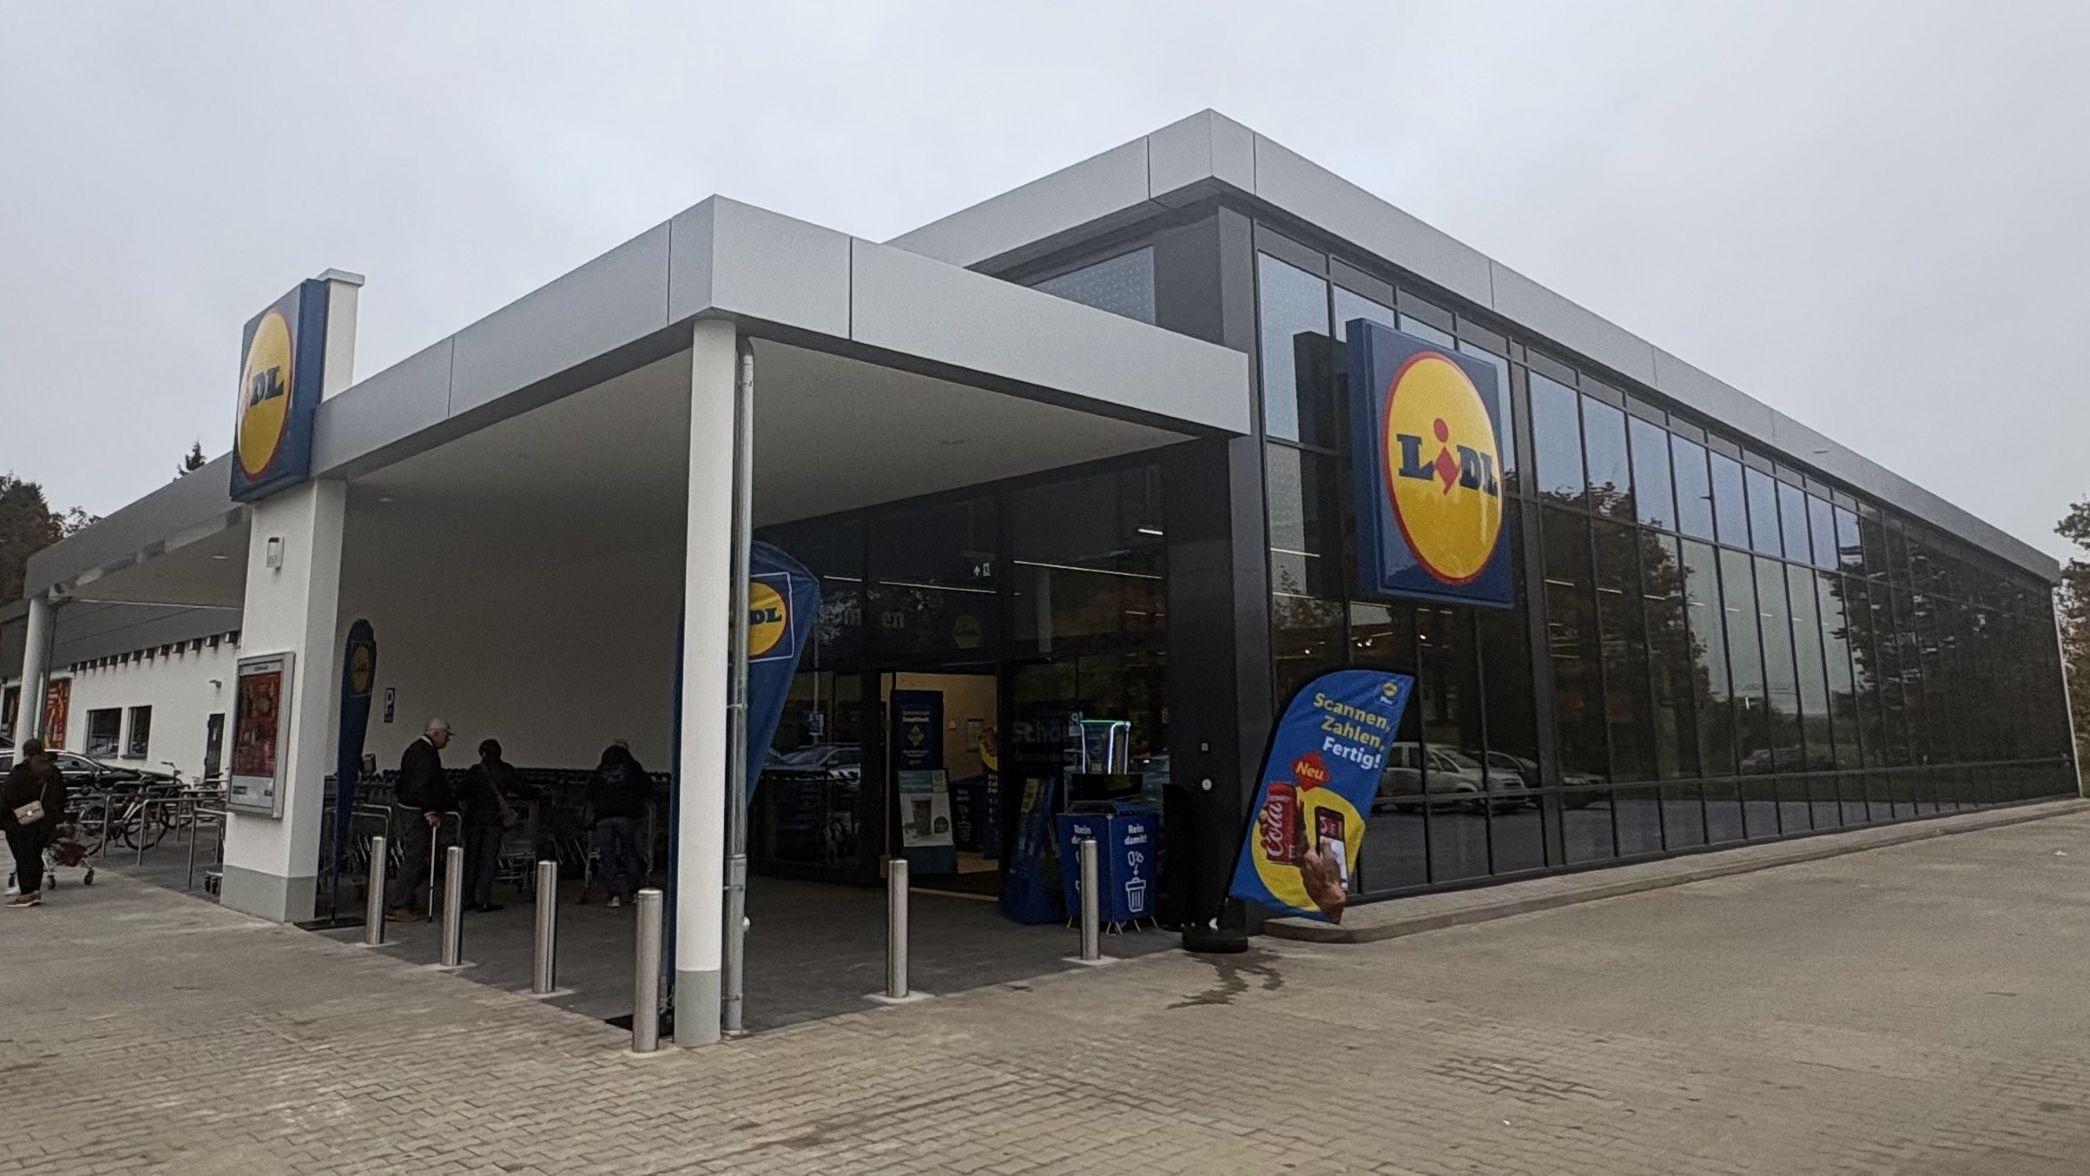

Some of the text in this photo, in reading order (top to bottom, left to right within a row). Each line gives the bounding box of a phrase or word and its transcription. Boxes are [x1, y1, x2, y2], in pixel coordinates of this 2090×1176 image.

[1313, 692, 1391, 732] Scannen,
[1321, 715, 1385, 751] Zahlen,
[1322, 736, 1382, 770] Fertig!
[1295, 761, 1324, 781] Neu
[1127, 823, 1145, 835] Rein
